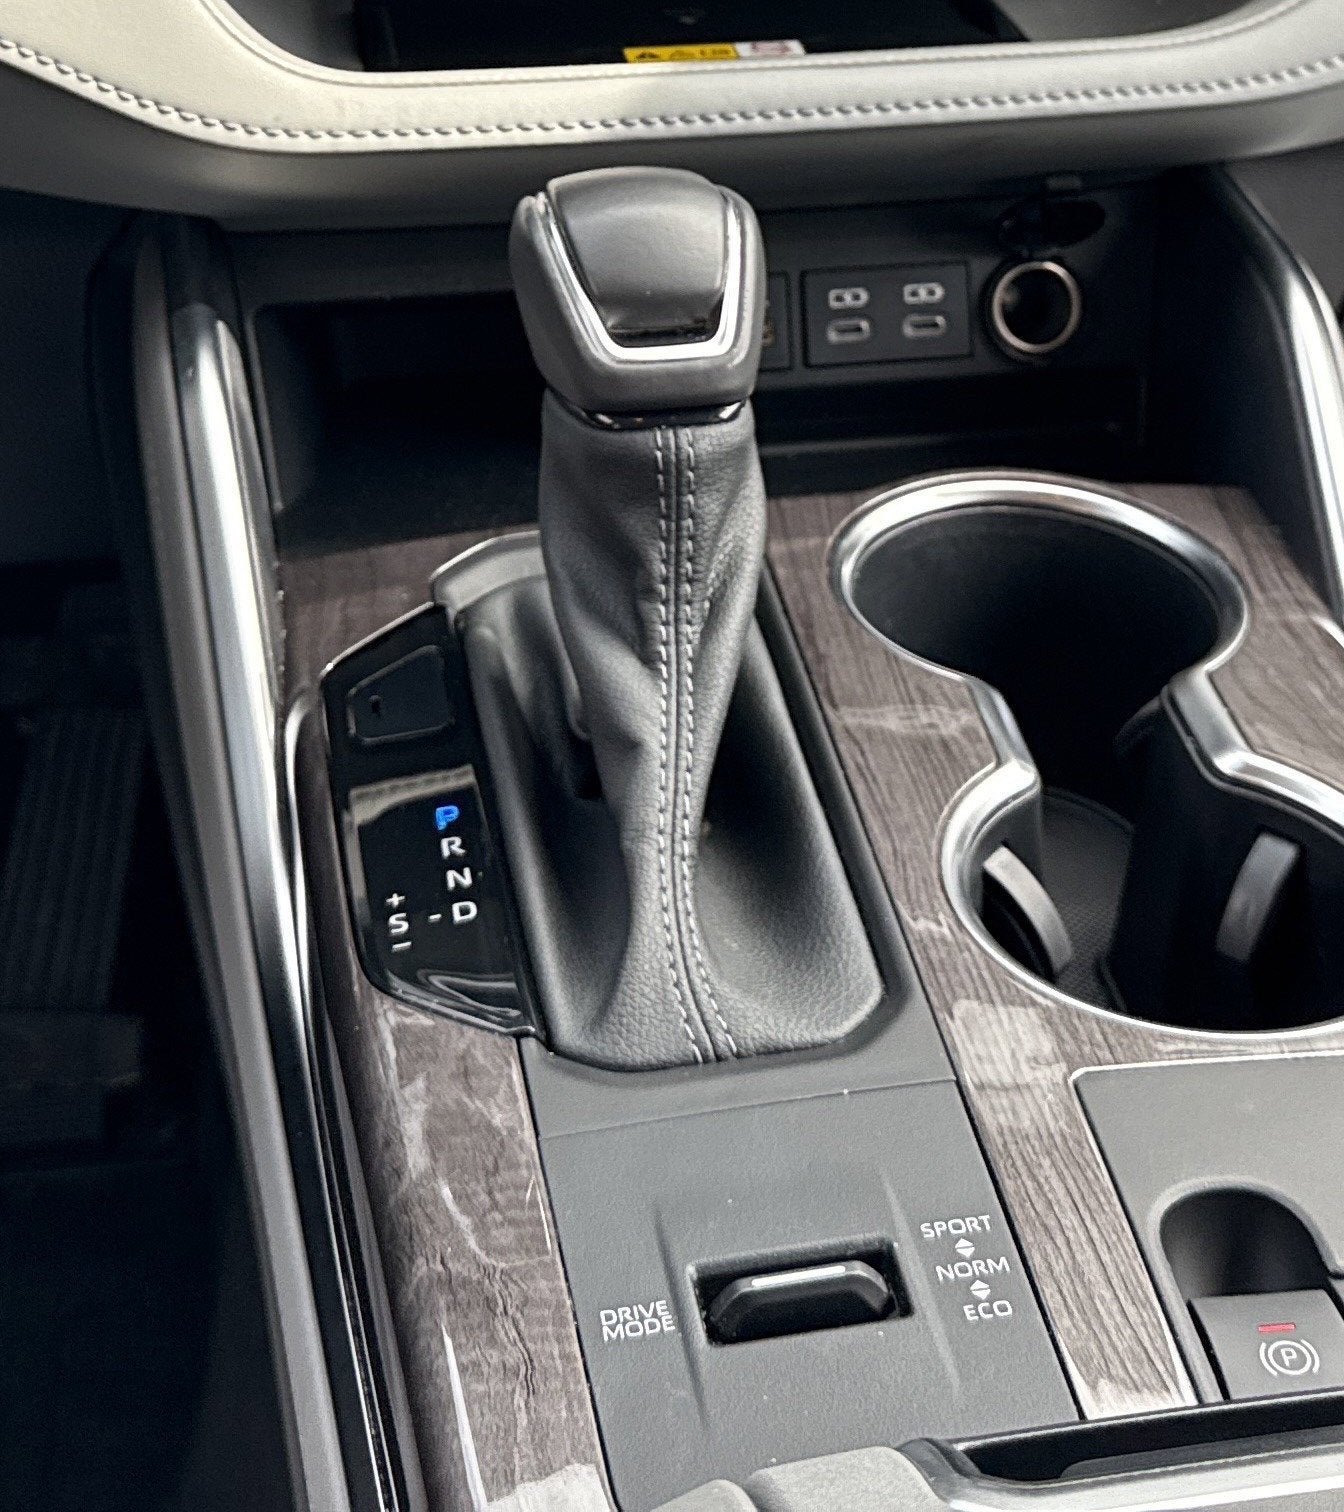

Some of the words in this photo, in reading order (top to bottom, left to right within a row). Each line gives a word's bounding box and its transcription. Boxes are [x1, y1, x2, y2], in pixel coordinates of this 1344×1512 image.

[434, 804, 460, 831] P
[440, 835, 467, 859] R
[445, 866, 473, 889] N
[387, 912, 410, 936] S
[451, 900, 478, 924] D
[919, 1214, 992, 1240] SPORT
[935, 1256, 1011, 1283] NORM
[599, 1299, 670, 1327] DRIVE
[962, 1299, 1013, 1322] ECO
[601, 1315, 676, 1343] MODE
